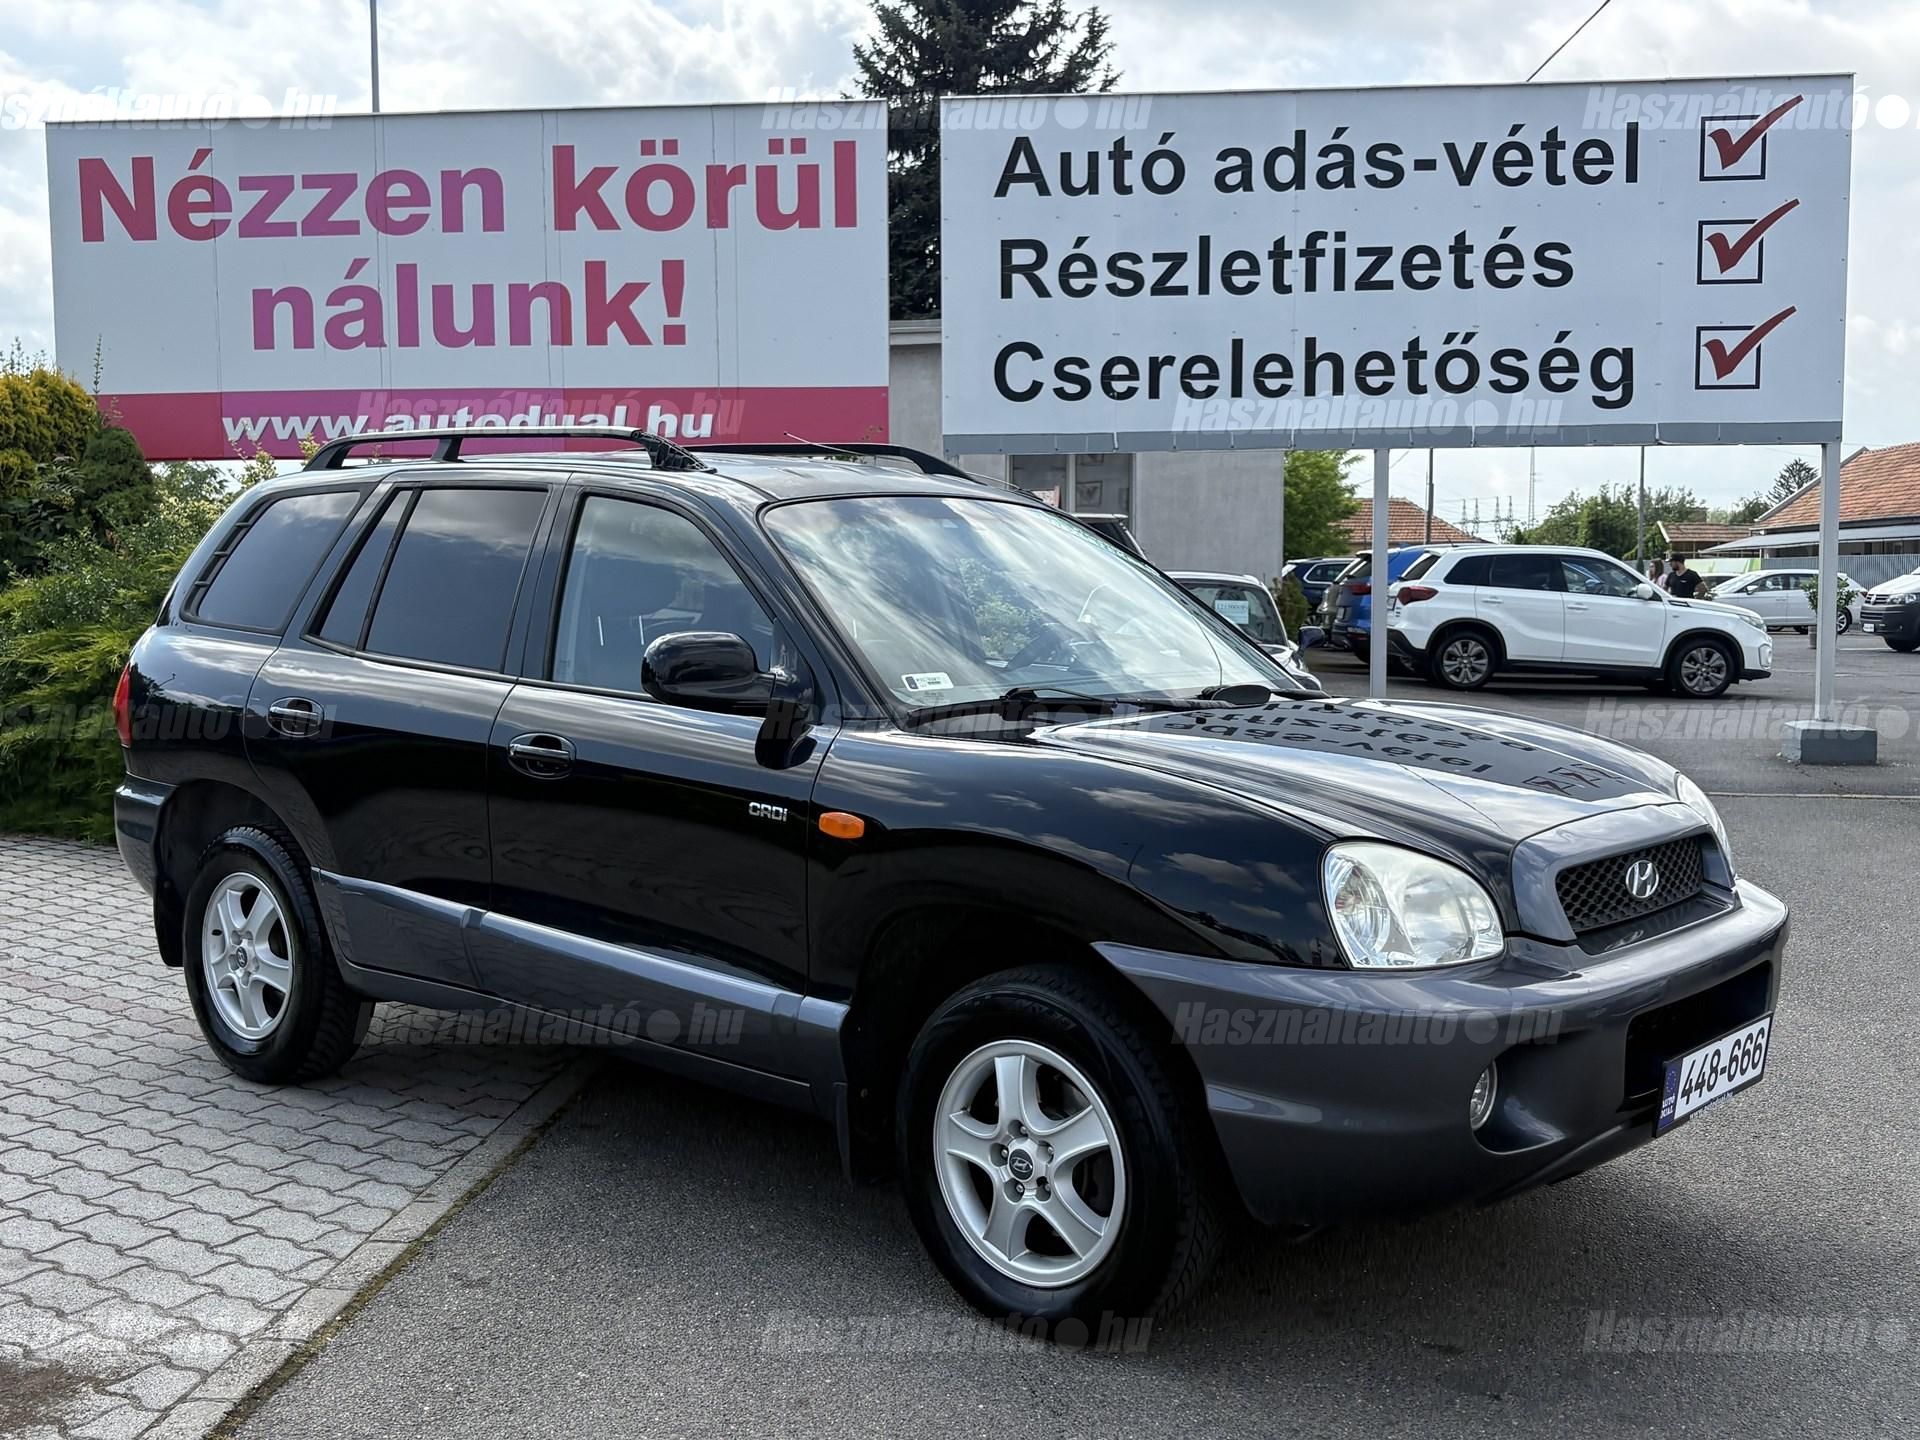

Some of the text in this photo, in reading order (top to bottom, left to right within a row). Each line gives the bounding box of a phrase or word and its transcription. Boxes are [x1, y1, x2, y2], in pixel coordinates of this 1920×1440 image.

[78, 138, 858, 243] Nézzen körül
[994, 122, 1639, 198] Autó adás-vétel
[1000, 225, 1574, 301] Részletfizetés
[251, 257, 688, 351] nálunk!
[994, 331, 1634, 410] Cserelehetőség
[1681, 1027, 1765, 1105] 448-666
